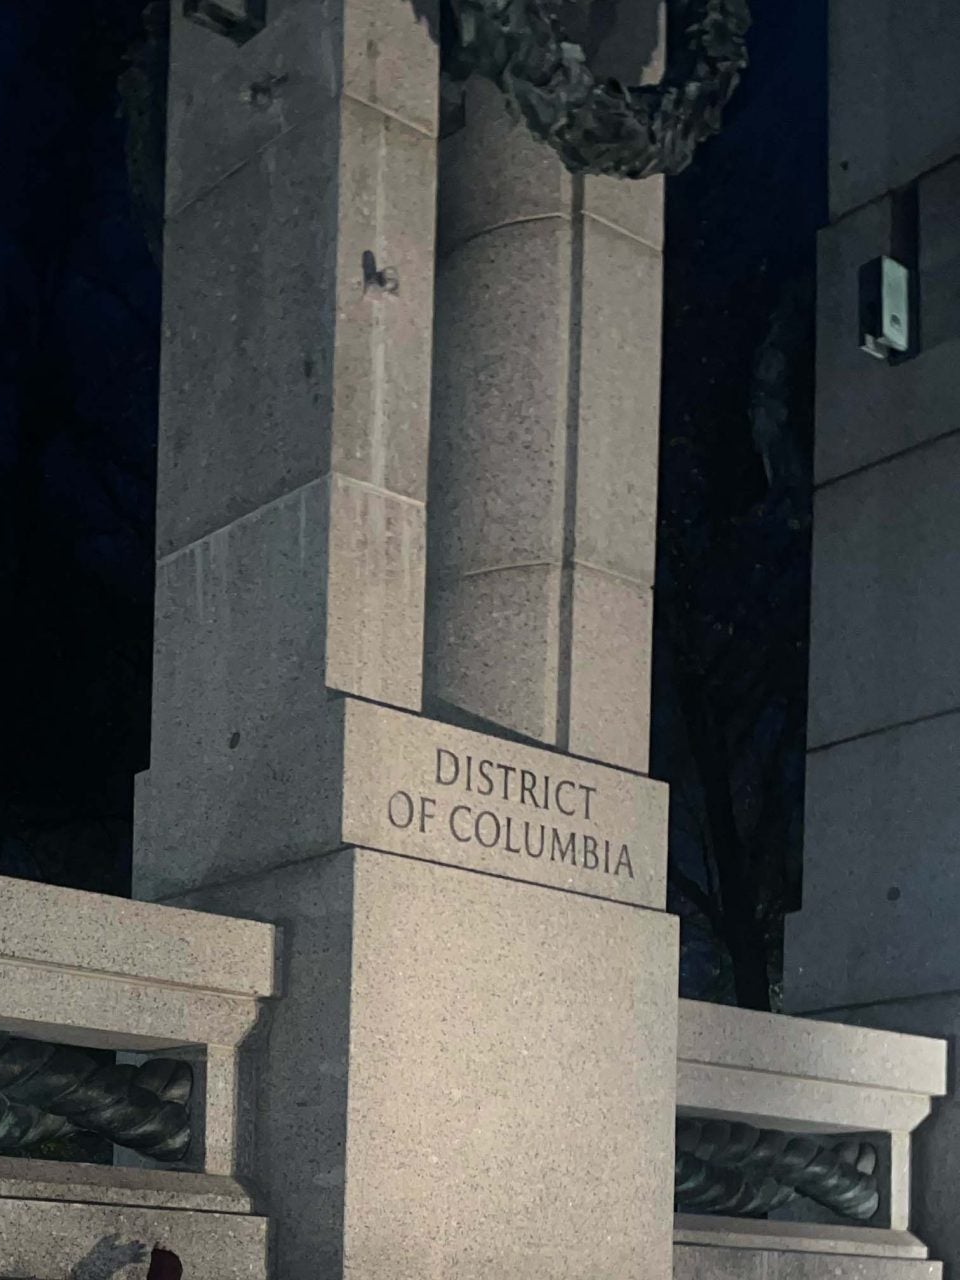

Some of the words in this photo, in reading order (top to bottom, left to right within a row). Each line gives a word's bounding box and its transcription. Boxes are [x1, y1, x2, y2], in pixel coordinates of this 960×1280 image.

[435, 748, 597, 820] DISTRICT
[388, 790, 436, 833] OF
[449, 805, 635, 879] COLUMBIA
